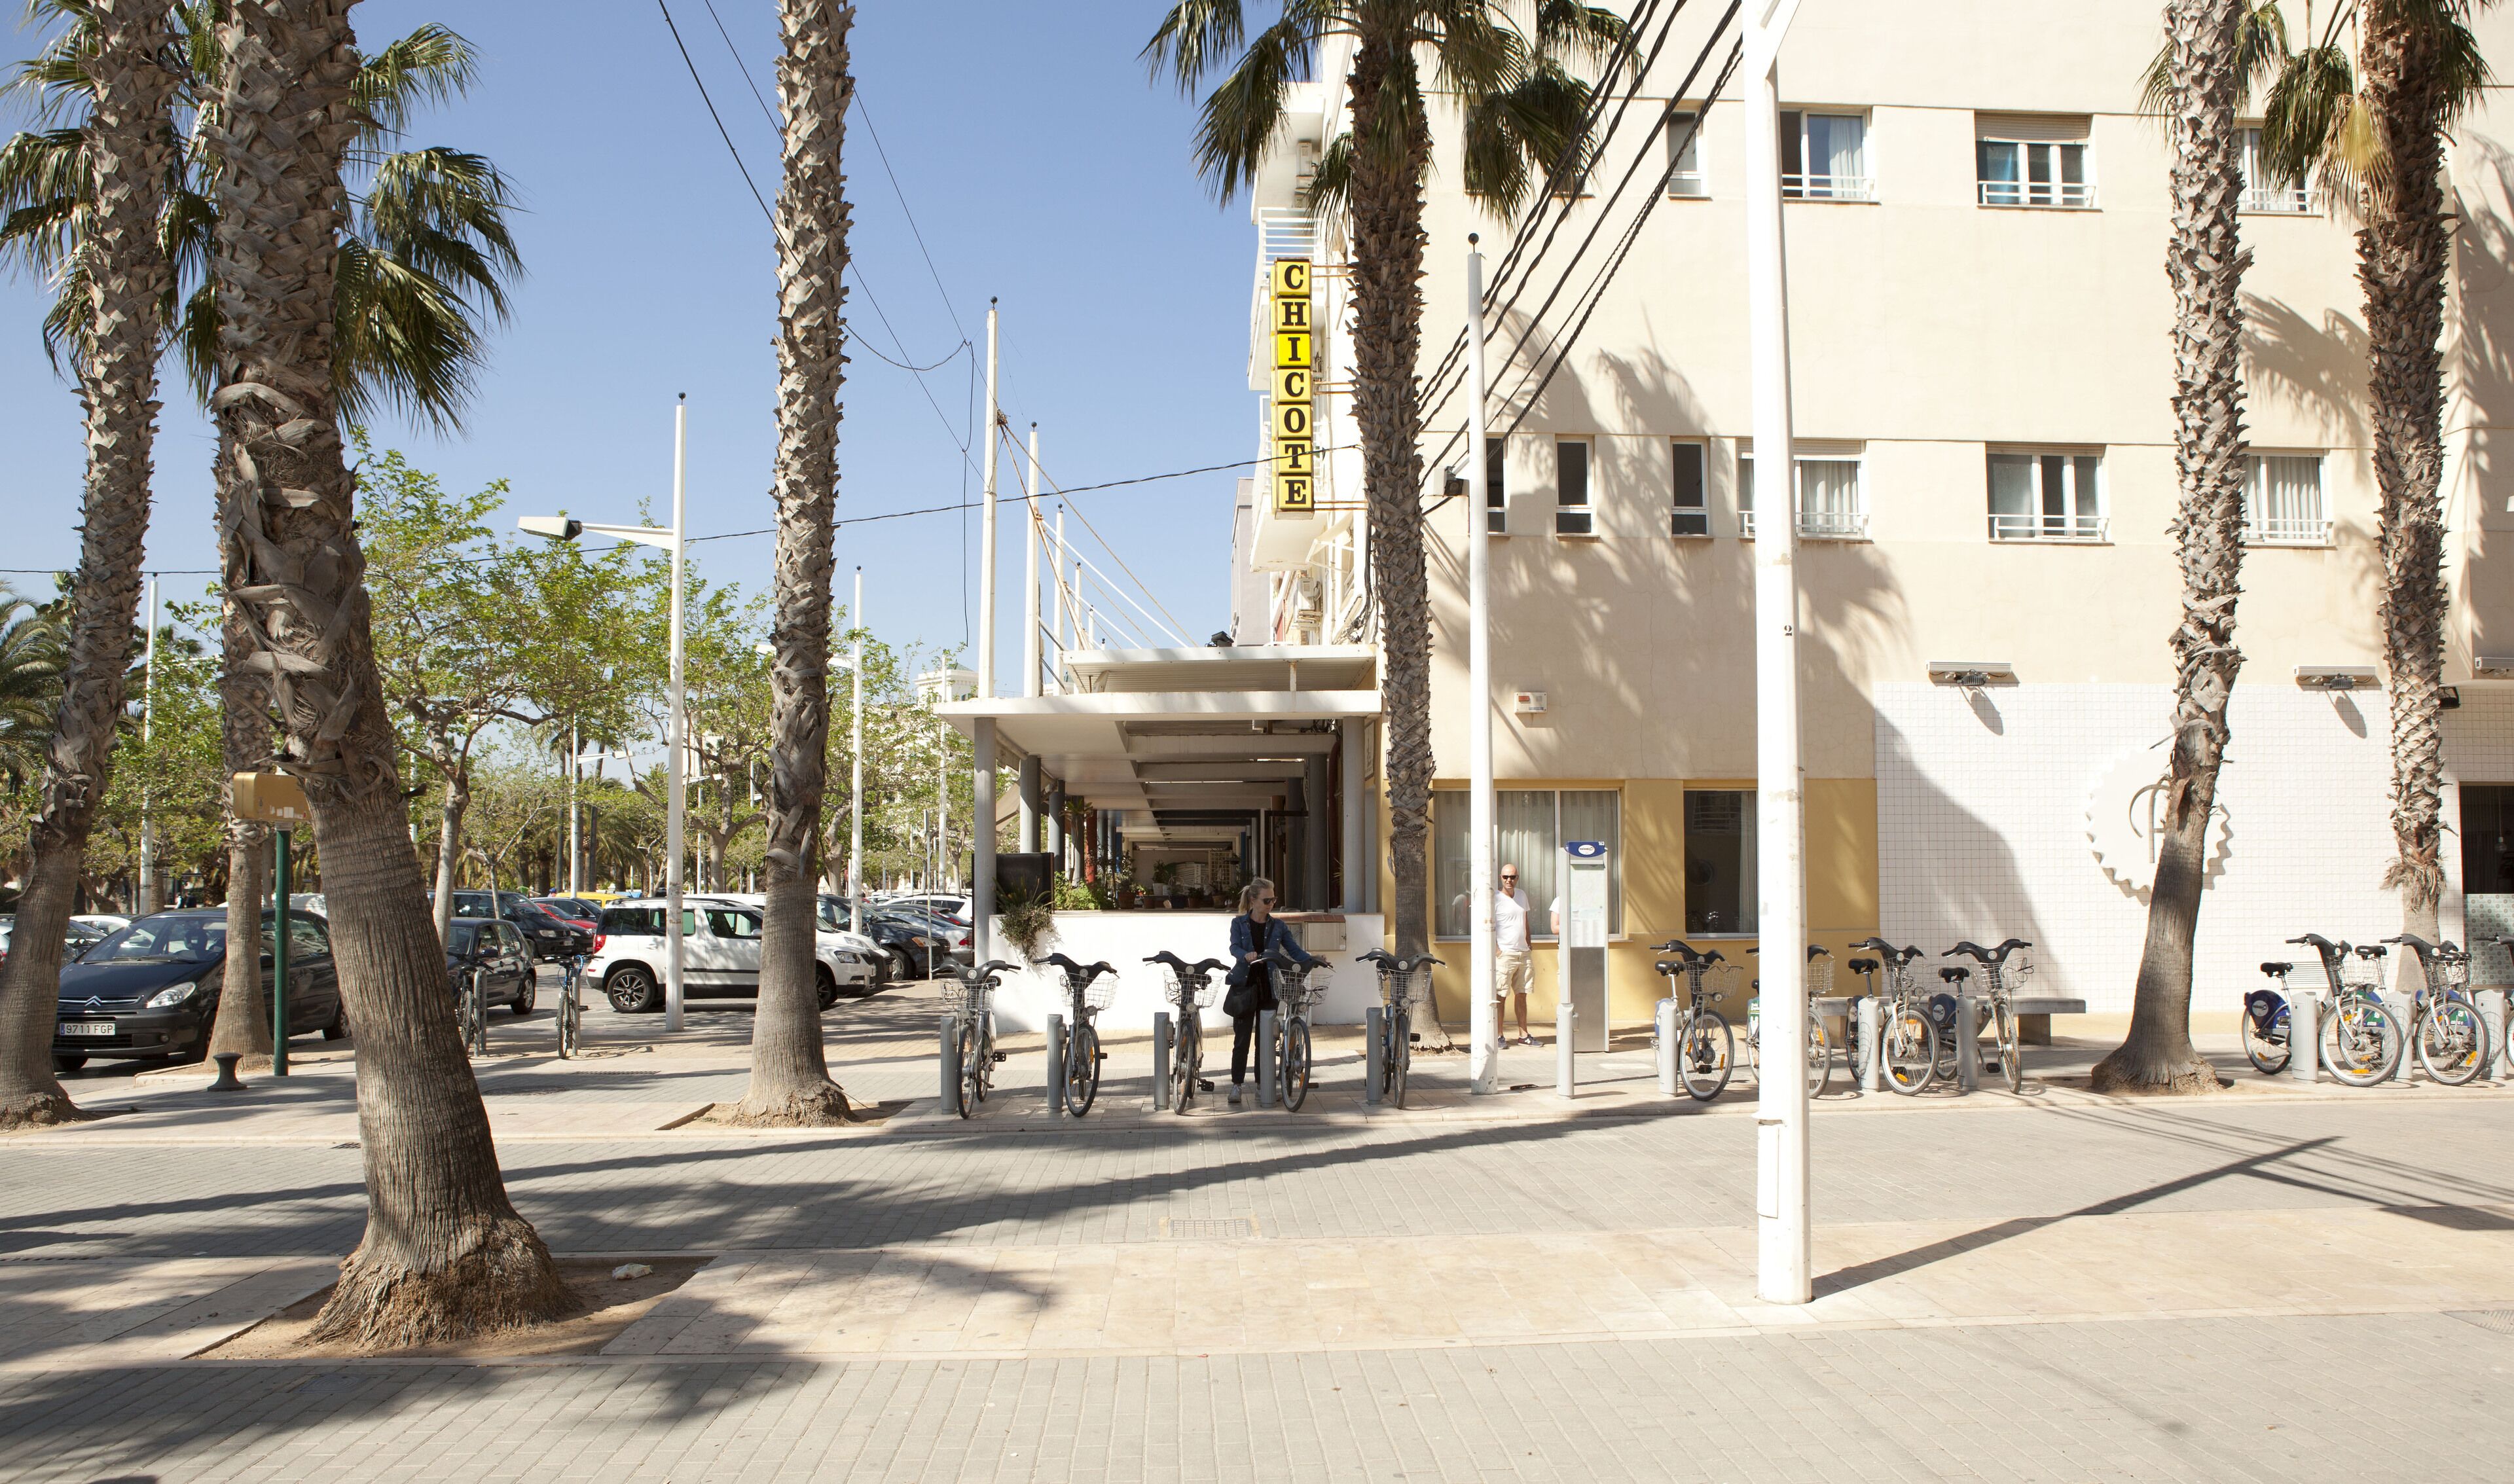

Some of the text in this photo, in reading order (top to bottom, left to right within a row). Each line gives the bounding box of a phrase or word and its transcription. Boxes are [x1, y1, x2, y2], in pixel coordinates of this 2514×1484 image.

[1281, 264, 1307, 505] CHICOTE
[66, 1025, 113, 1034] 9711 FGP
